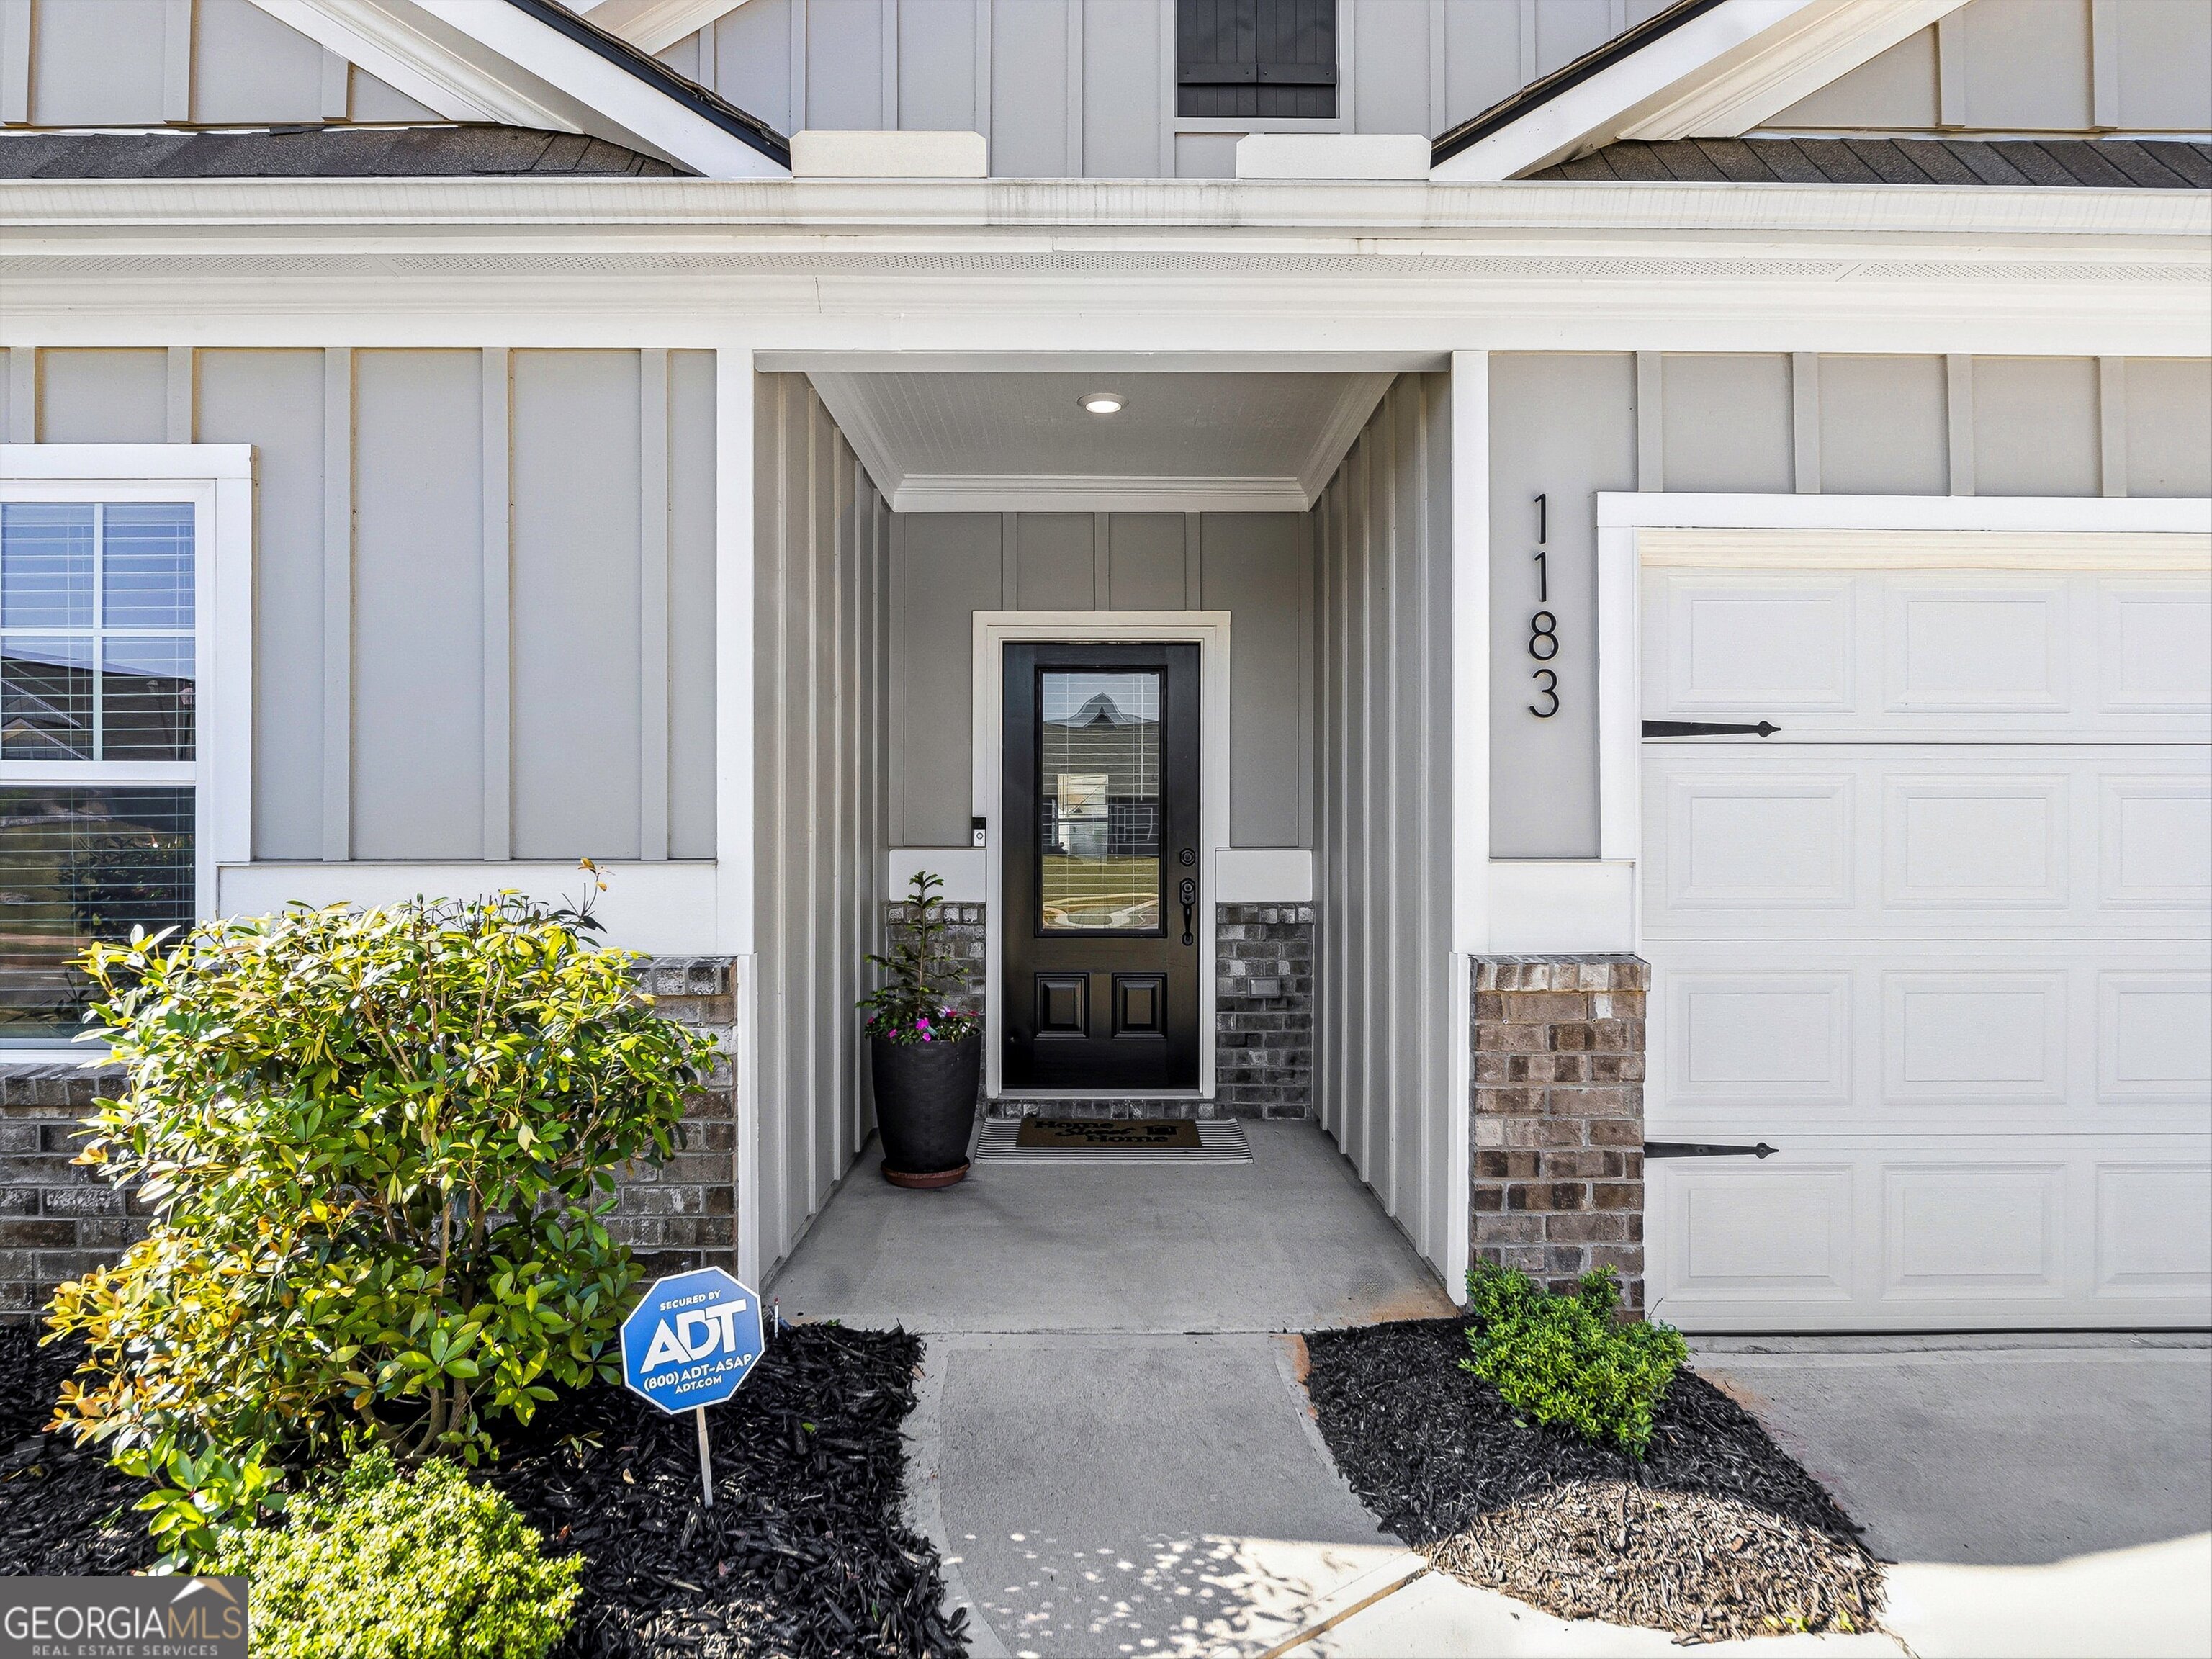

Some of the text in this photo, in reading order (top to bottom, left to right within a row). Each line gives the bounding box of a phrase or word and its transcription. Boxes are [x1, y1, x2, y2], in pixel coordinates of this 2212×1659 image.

[1528, 493, 1560, 718] 1183
[660, 1290, 721, 1312] SECURED BY
[640, 1298, 747, 1374] ADT
[644, 1353, 752, 1392] (800) ADT-ASAP
[675, 1375, 722, 1395] ADT.COM
